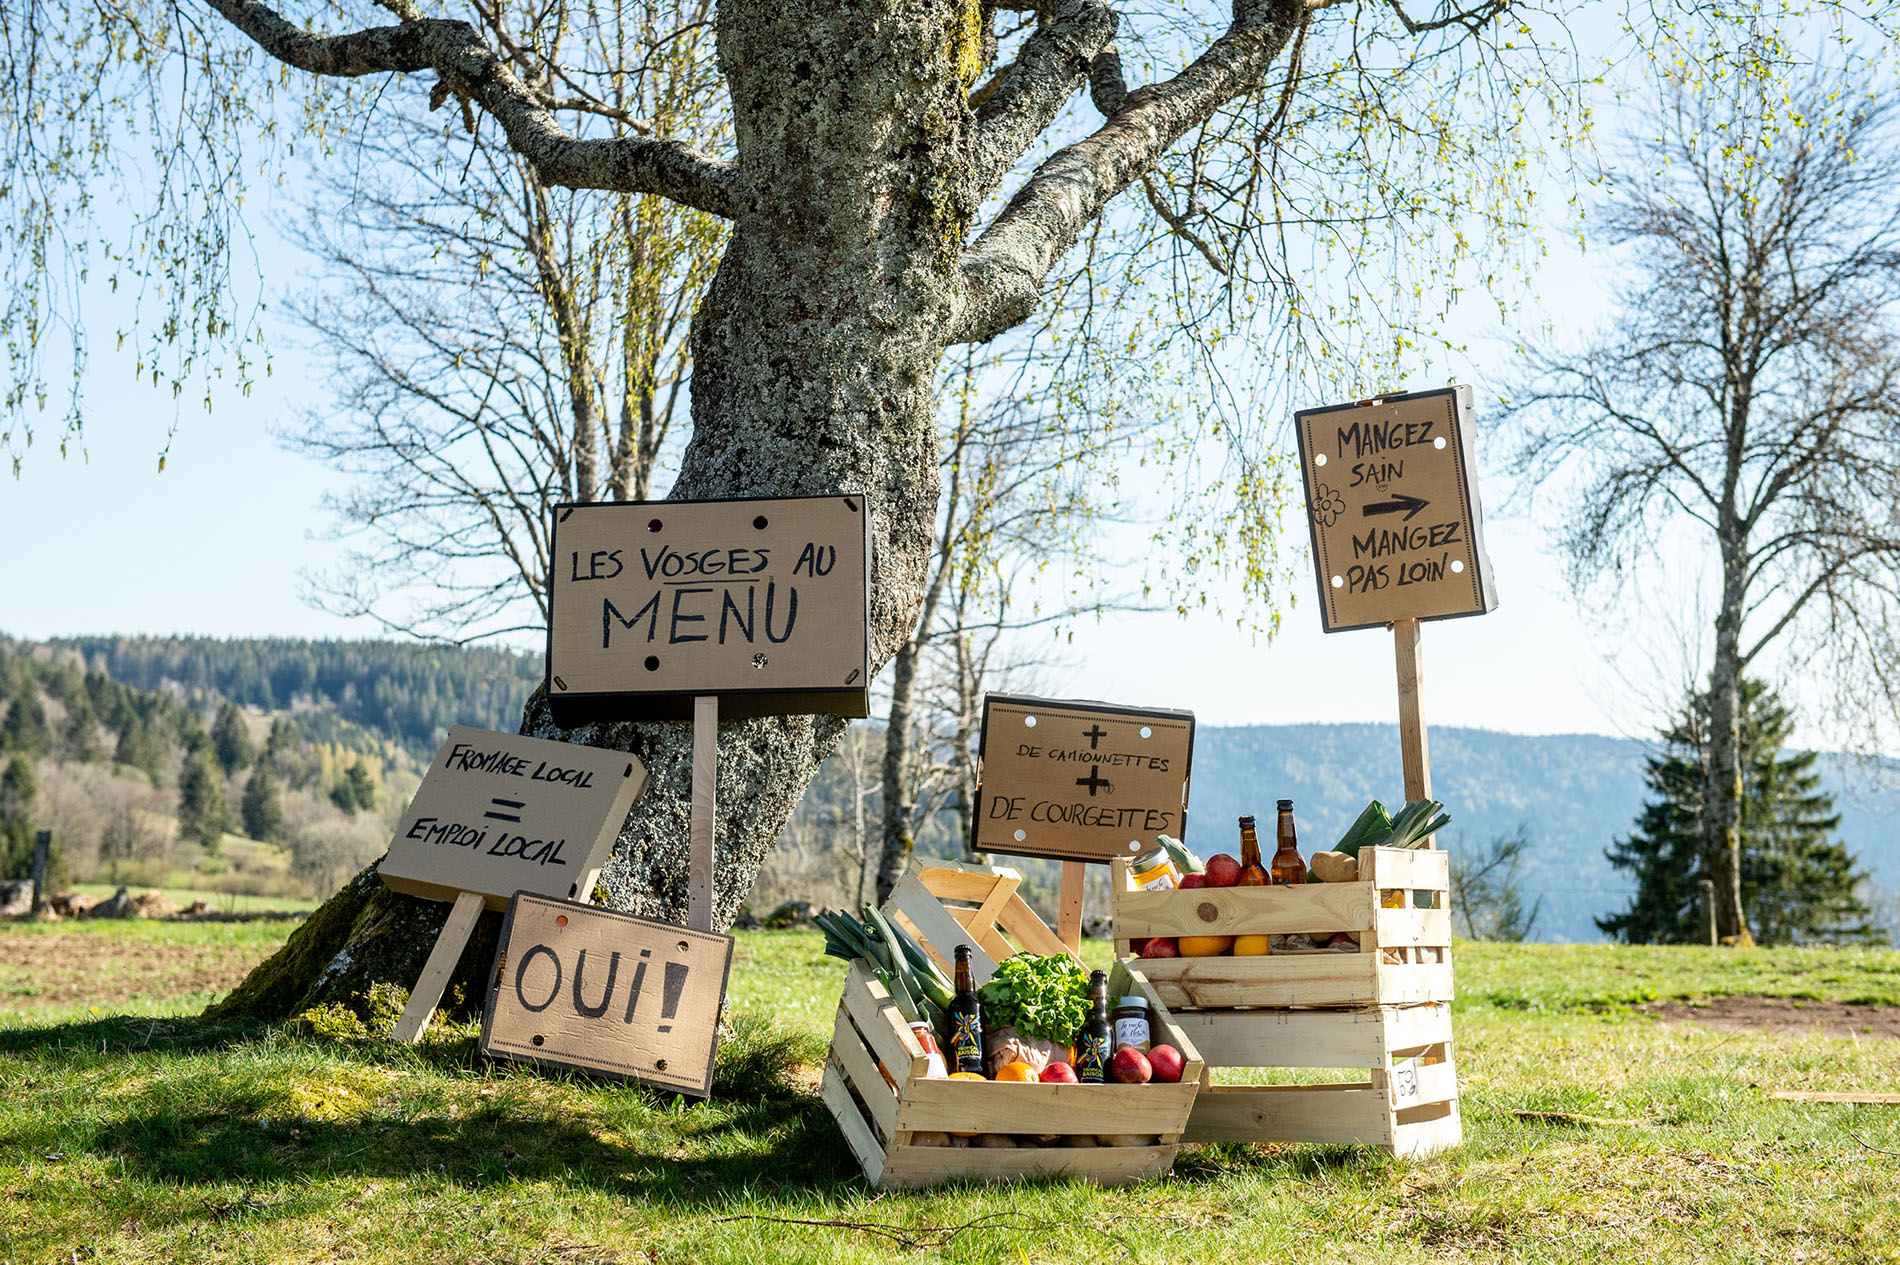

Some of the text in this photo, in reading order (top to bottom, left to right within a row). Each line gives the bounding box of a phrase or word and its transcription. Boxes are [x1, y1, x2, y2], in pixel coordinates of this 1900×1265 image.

[1337, 420, 1435, 459] MANGEZ
[1352, 521, 1462, 559] MANGEZ
[571, 543, 836, 582] LES VOSGES AU
[1346, 564, 1390, 594] PAS
[602, 578, 798, 649] MENU
[445, 743, 595, 789] FROMAGE LOCAL
[1016, 744, 1043, 758] DE
[989, 796, 1176, 832] DE COURGETTES
[487, 832, 567, 866] LOCAL
